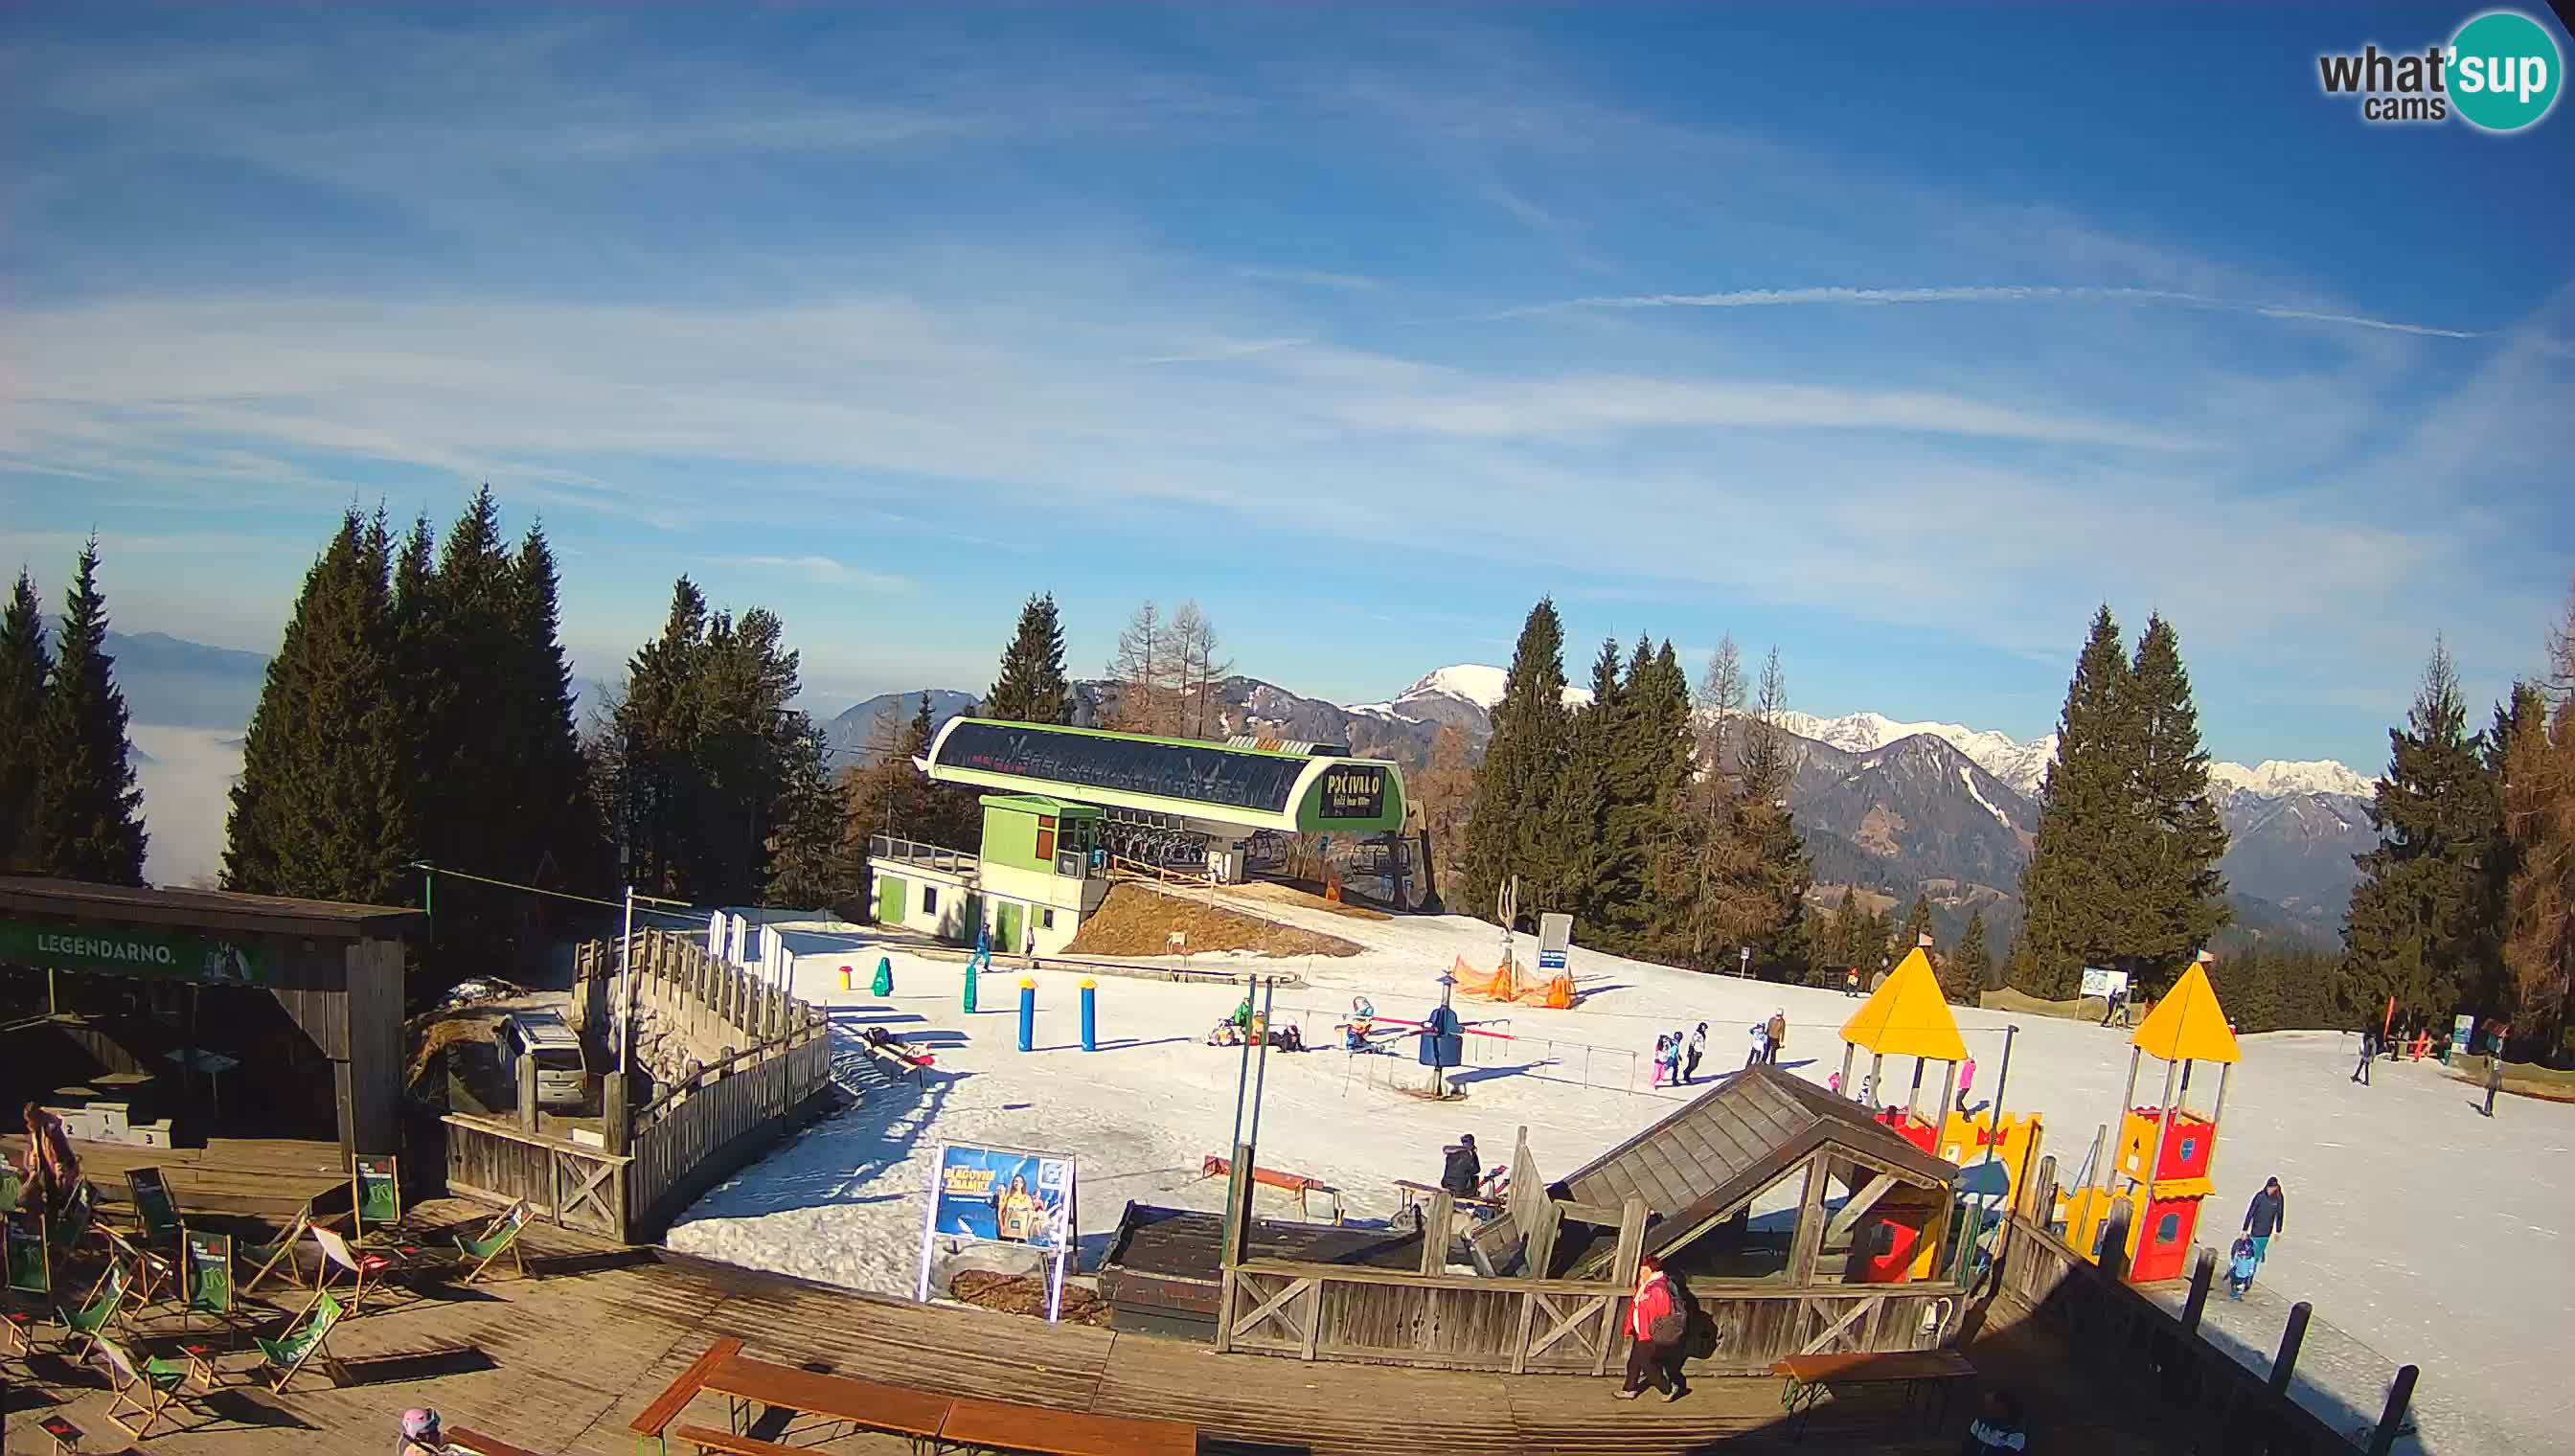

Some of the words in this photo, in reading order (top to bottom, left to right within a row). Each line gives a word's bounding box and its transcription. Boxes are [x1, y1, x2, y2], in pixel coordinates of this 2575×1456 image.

[37, 934, 177, 965] LEGENDARNO.
[66, 1124, 74, 1135] 2
[145, 1133, 154, 1145] 3
